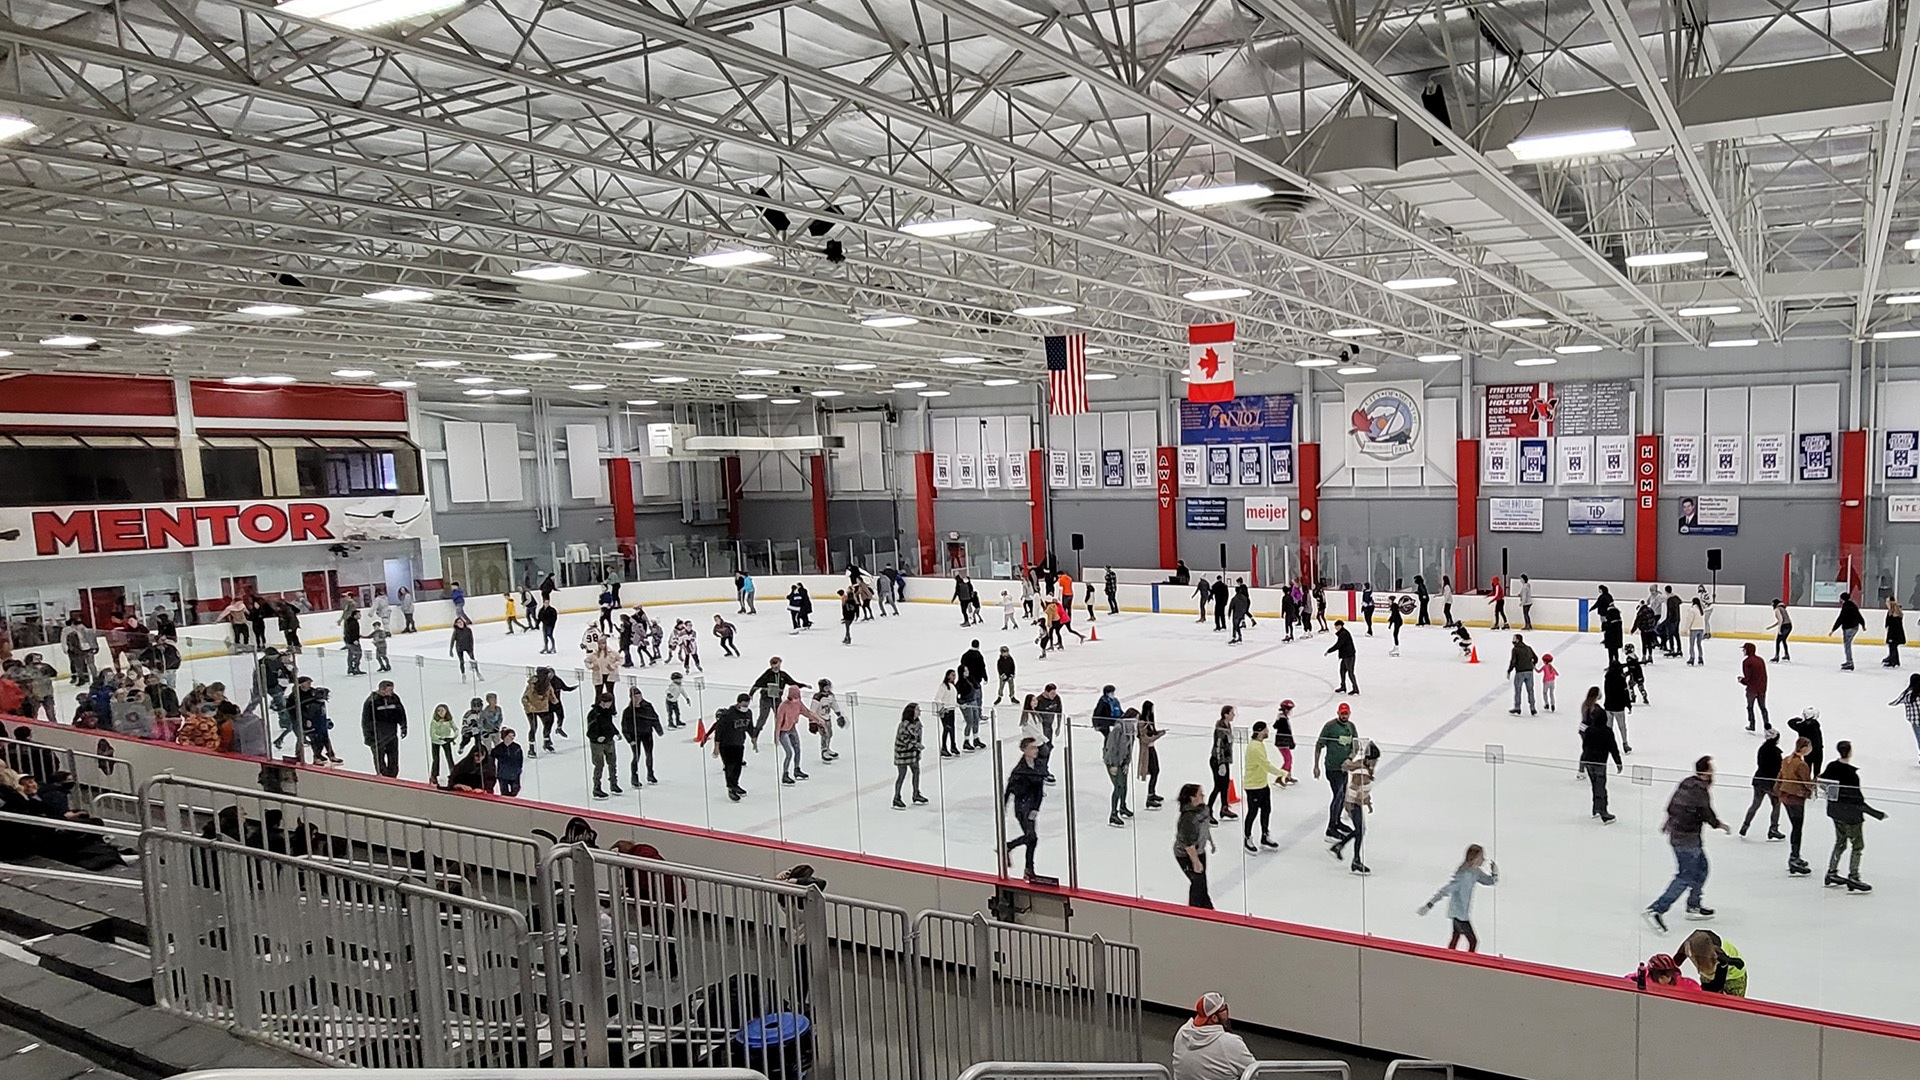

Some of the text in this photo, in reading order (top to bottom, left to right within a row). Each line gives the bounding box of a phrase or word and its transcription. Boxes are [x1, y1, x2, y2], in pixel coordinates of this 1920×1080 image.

[1489, 406, 1528, 414] 2021-2022
[1158, 455, 1170, 508] AWAY
[1640, 445, 1654, 509] HOME
[31, 503, 335, 556] MENTOR
[1246, 504, 1287, 522] meijer
[586, 633, 598, 643] 98
